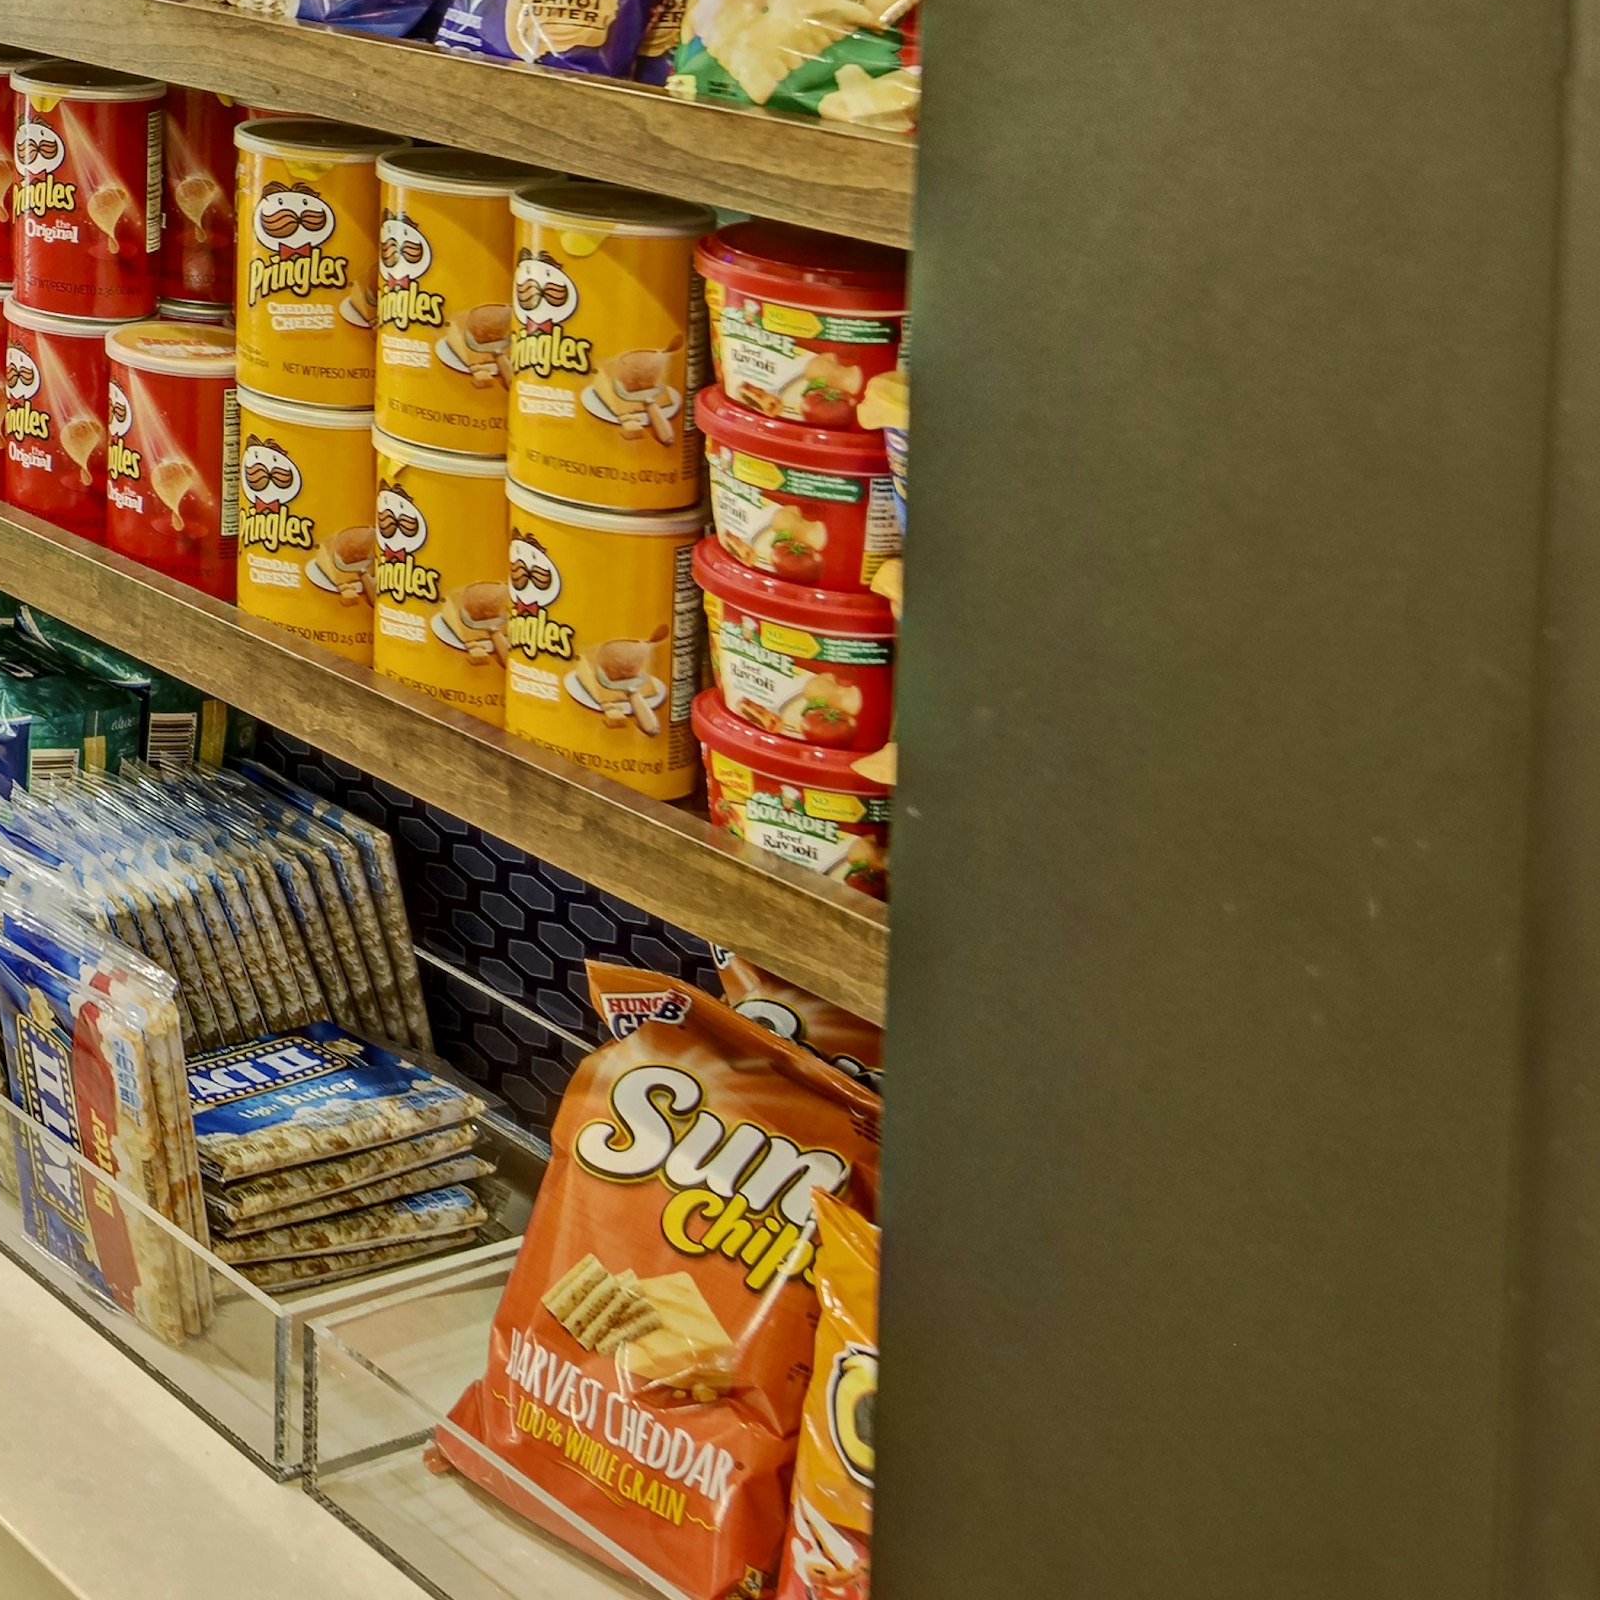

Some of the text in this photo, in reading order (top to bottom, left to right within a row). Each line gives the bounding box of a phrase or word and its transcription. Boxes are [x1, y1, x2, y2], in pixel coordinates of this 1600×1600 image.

[24, 218, 79, 244] Original
[247, 244, 348, 304] Pringles
[269, 313, 335, 331] CHEESE
[282, 360, 301, 373] NET
[340, 367, 369, 379] NETO
[588, 464, 619, 480] NETO
[193, 1061, 261, 1098] ACT
[279, 1076, 357, 1110] Butter
[576, 1065, 850, 1230] Sun
[505, 1328, 736, 1501] HARVEST CHEDDAR
[515, 1394, 687, 1527] 100% WHOLE GRAIN
